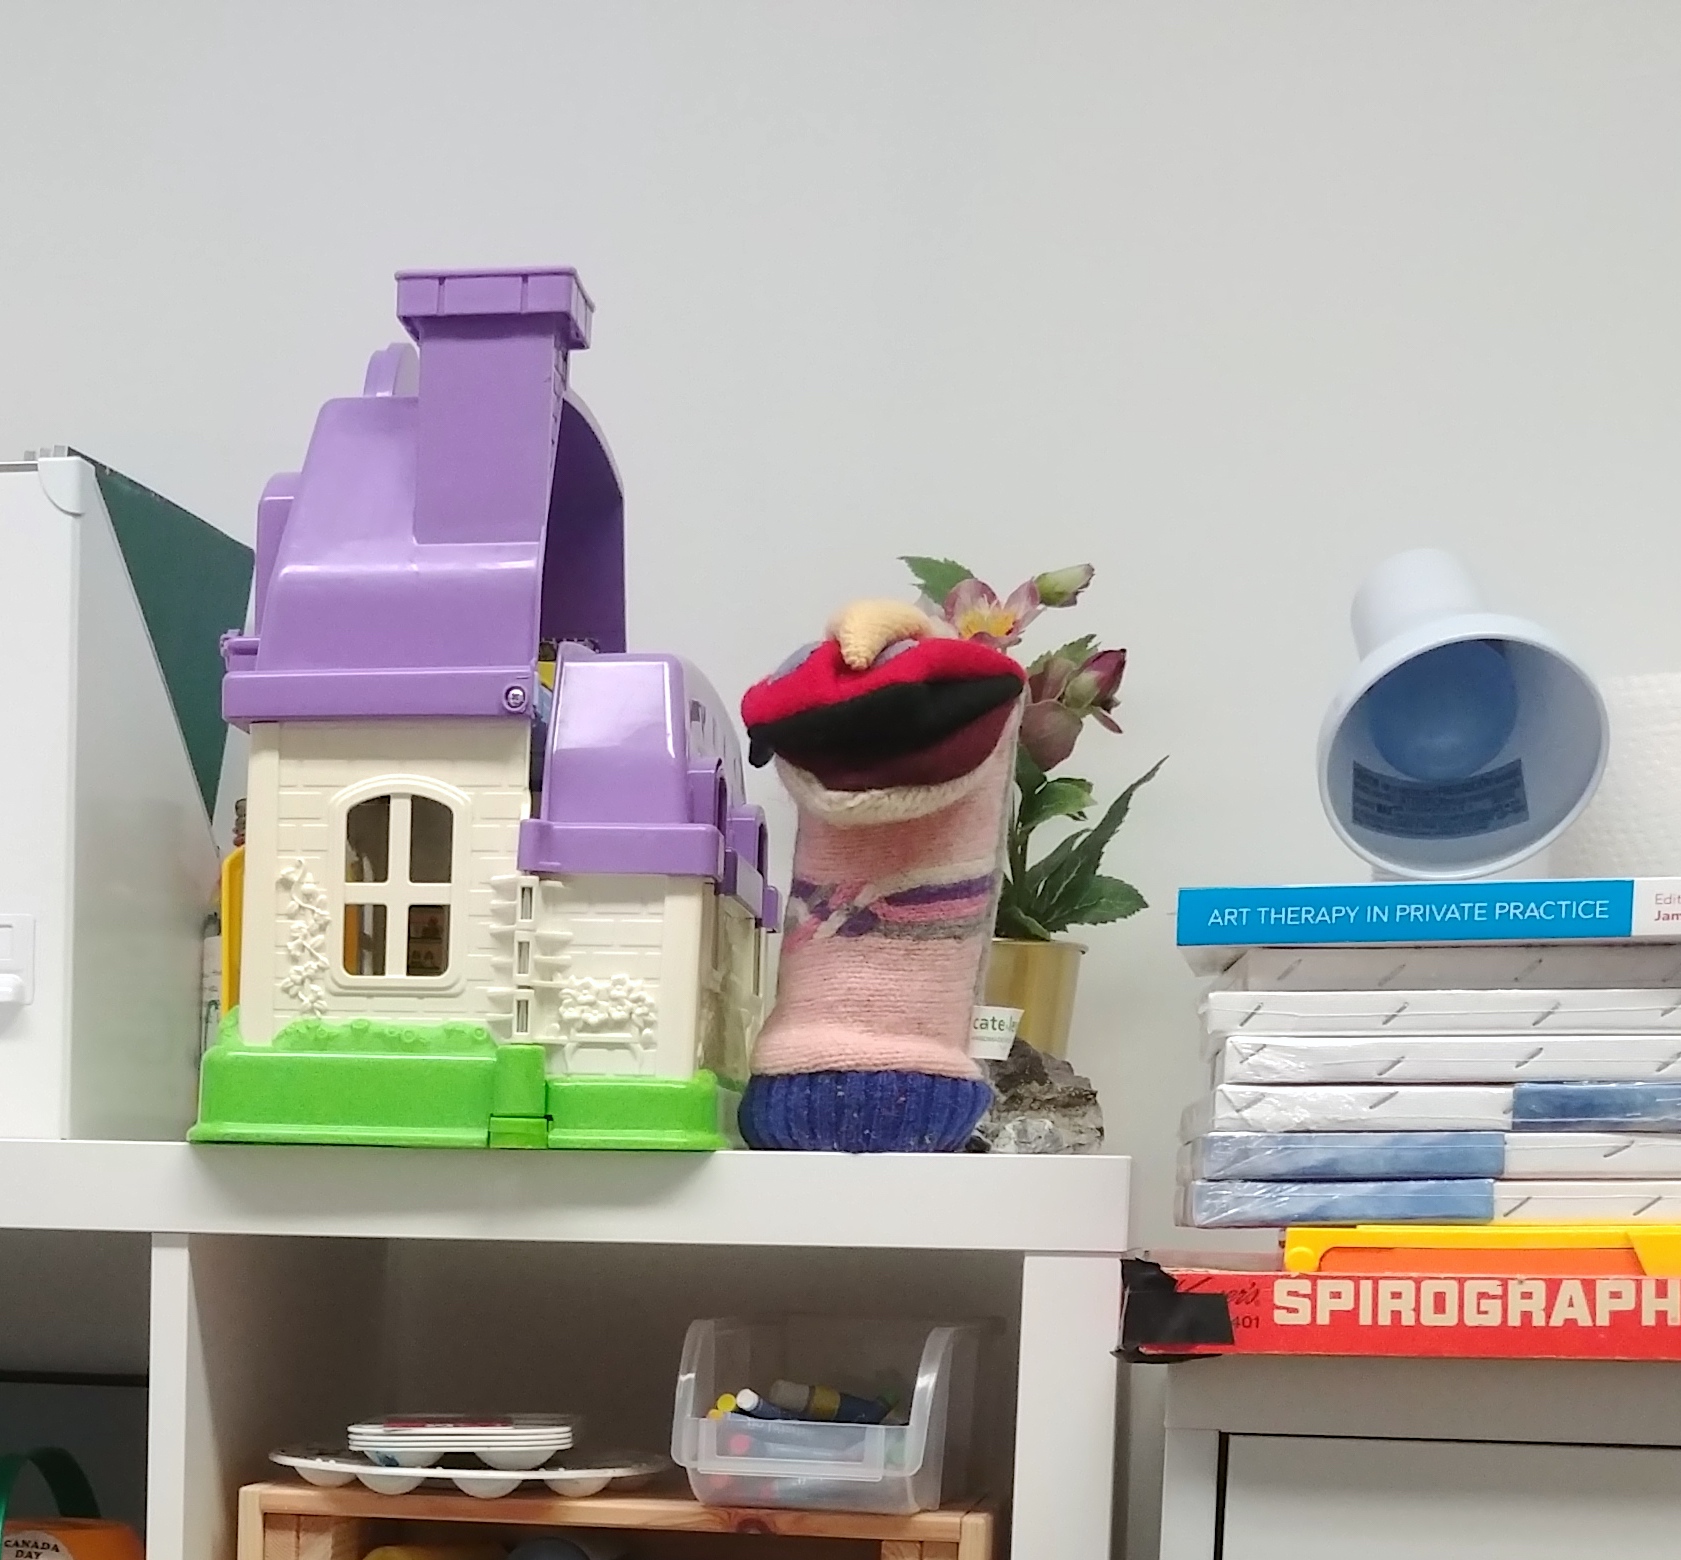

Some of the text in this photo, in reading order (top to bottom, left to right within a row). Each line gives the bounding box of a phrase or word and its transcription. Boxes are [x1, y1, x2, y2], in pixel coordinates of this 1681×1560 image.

[1208, 900, 1609, 926] ART THERAPY IN PRIVATE PRACTICE
[1273, 1279, 1681, 1327] SPIROGRAPH
[4, 1539, 60, 1553] CANADA
[15, 1549, 43, 1560] DAY
